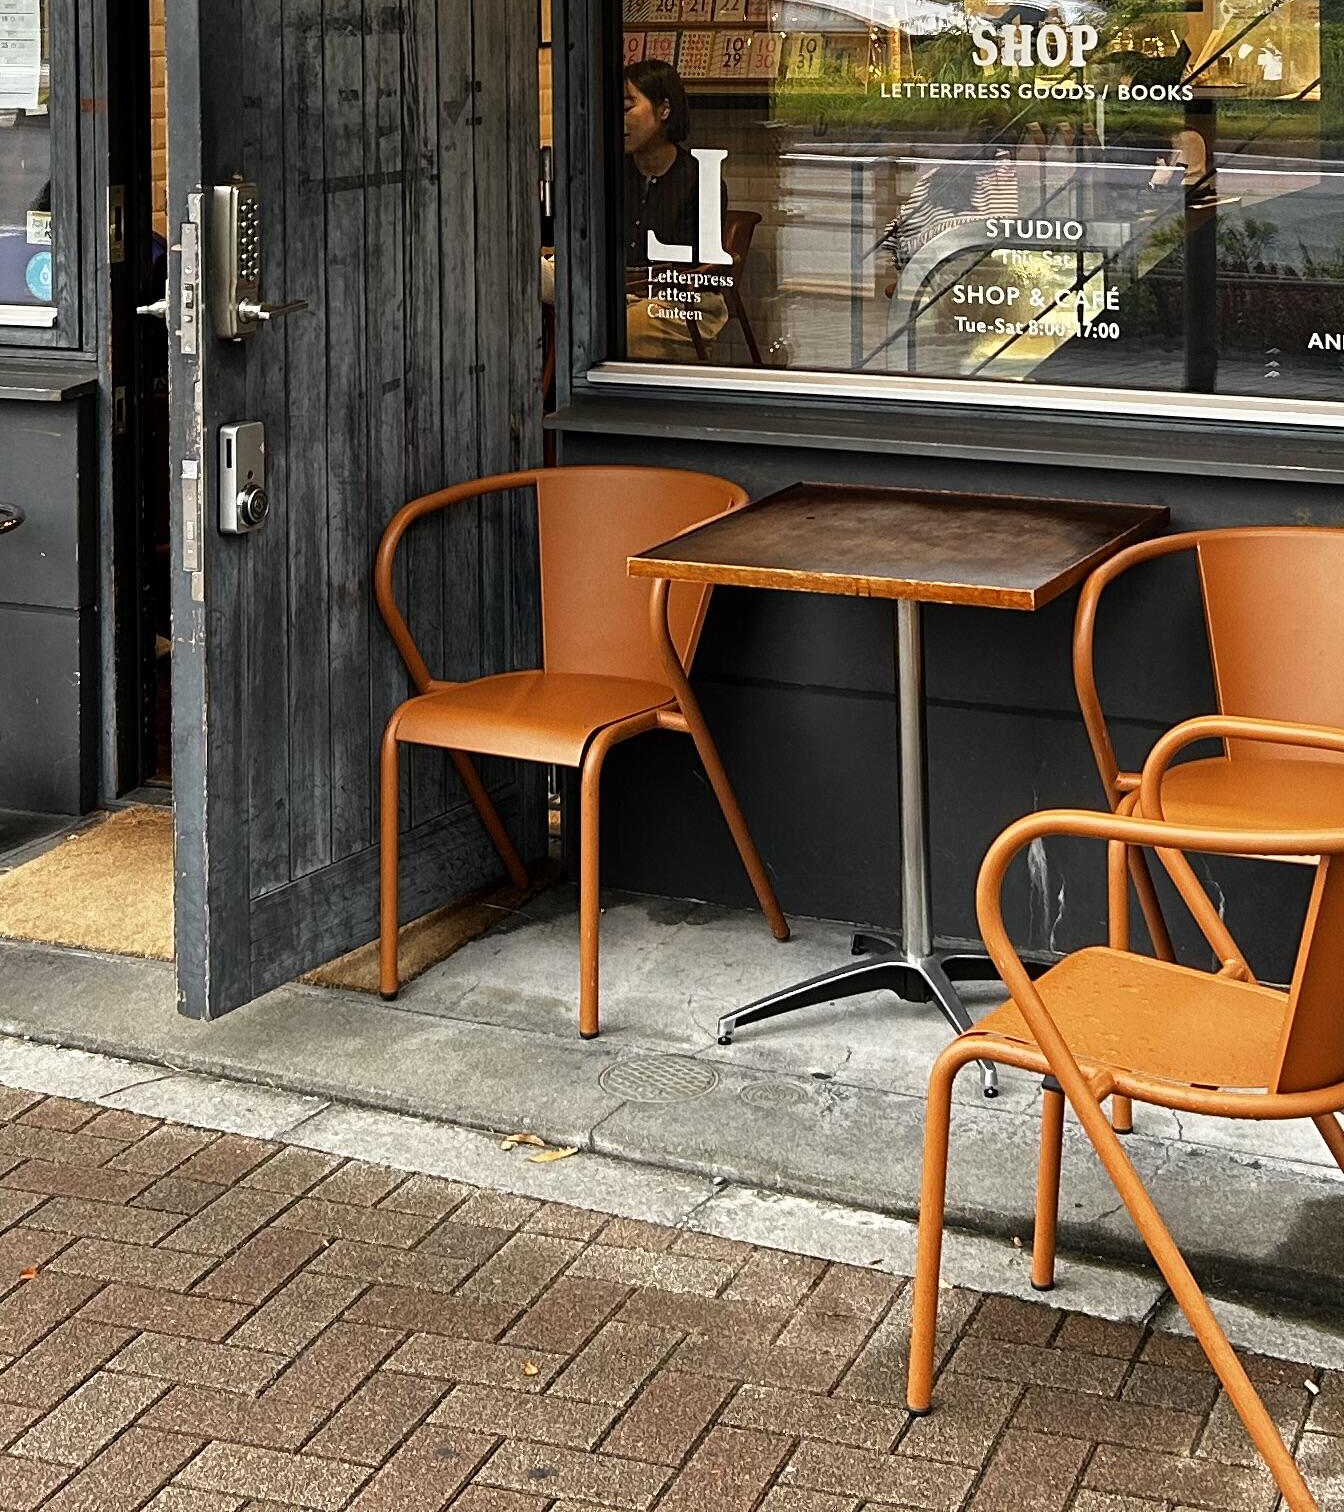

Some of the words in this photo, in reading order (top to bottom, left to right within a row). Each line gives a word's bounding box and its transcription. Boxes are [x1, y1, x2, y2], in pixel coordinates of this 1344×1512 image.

[725, 38, 744, 52] 10
[758, 38, 776, 53] 10
[799, 38, 817, 54] 10
[971, 24, 1099, 68] SHOP
[723, 52, 742, 67] 29
[755, 53, 775, 69] 30
[796, 53, 814, 70] 31
[879, 82, 1012, 100] LETTERPRESS
[1018, 83, 1096, 101] GOODS
[1117, 83, 1194, 102] BOOKS
[986, 218, 1084, 241] STUDIO
[647, 266, 734, 288] Letterpress
[647, 285, 702, 304] Letters
[952, 284, 1021, 306] SHOP
[1029, 288, 1045, 307] &
[1055, 285, 1120, 311] CAFÉ
[647, 303, 703, 322] Canteen
[953, 316, 1025, 336] Tue-Sat
